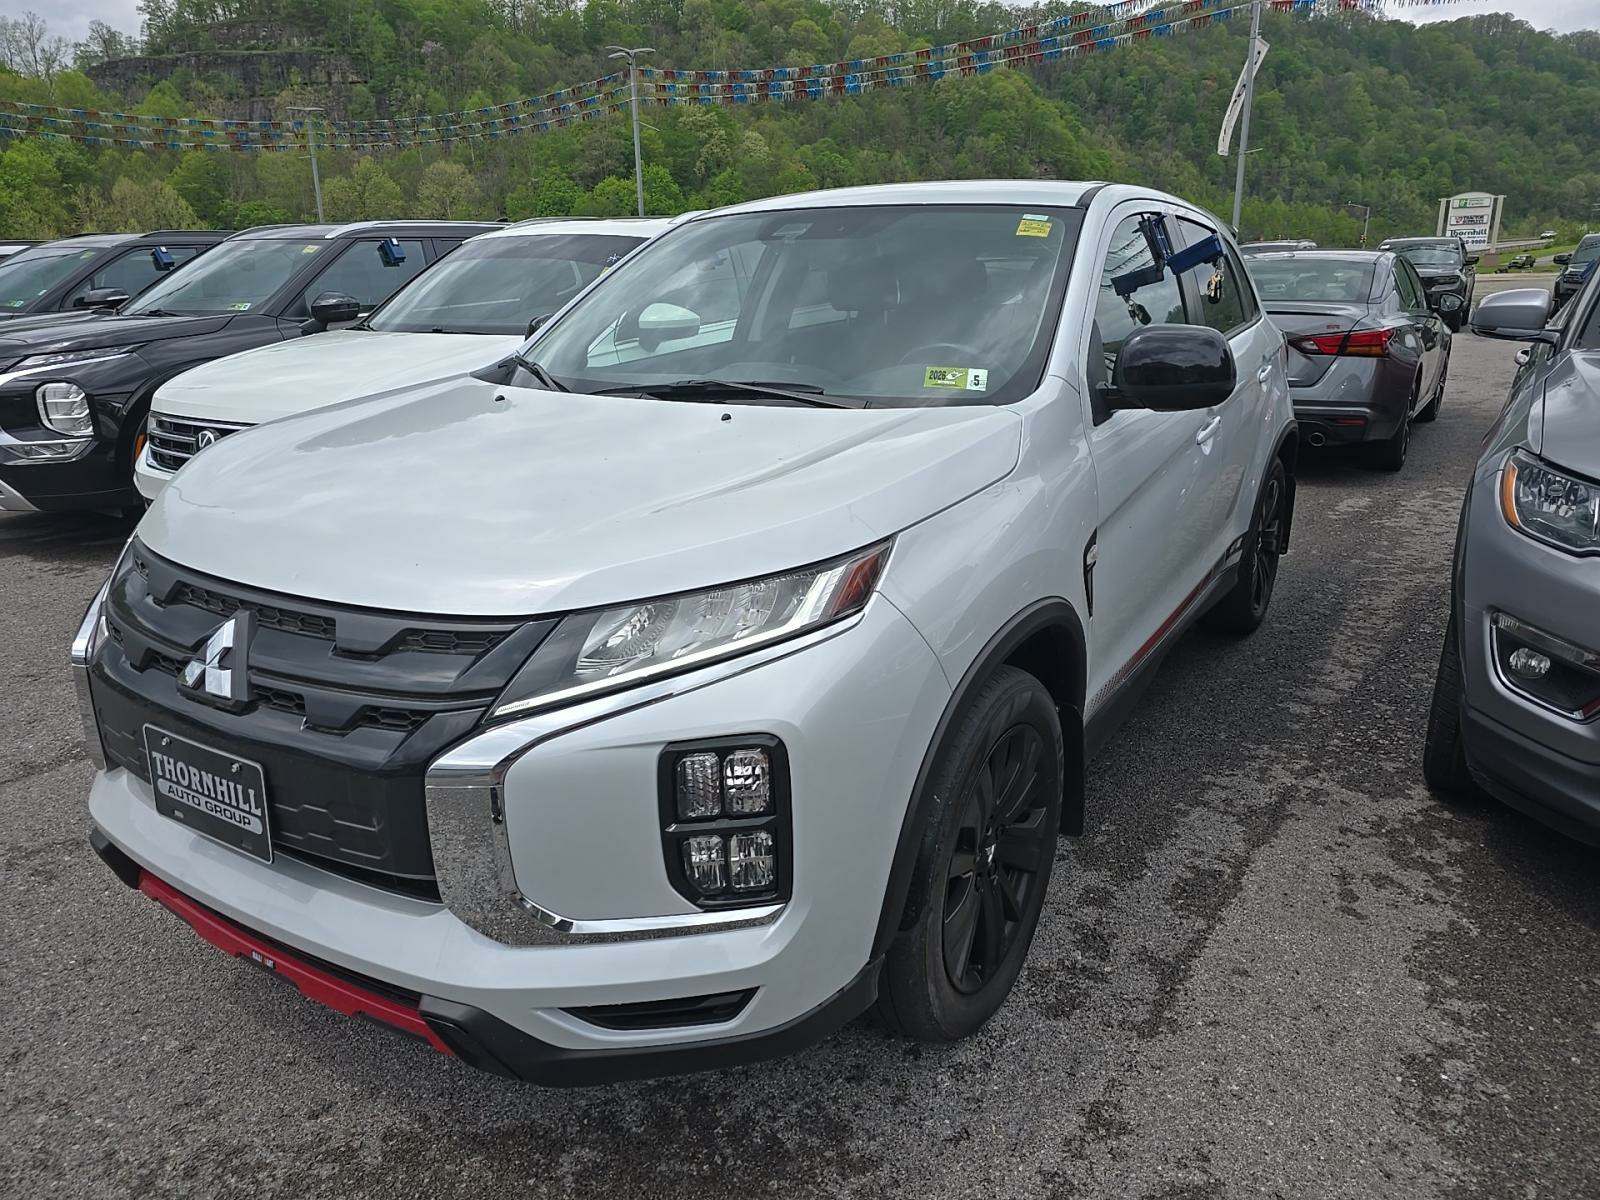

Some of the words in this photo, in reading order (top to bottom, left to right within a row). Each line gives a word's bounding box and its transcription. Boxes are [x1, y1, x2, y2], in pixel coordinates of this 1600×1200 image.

[929, 370, 947, 381] 2026
[973, 375, 980, 386] 5
[151, 751, 262, 816] THORNHILL
[167, 784, 201, 807] AUTO
[204, 800, 252, 827] GROUP
